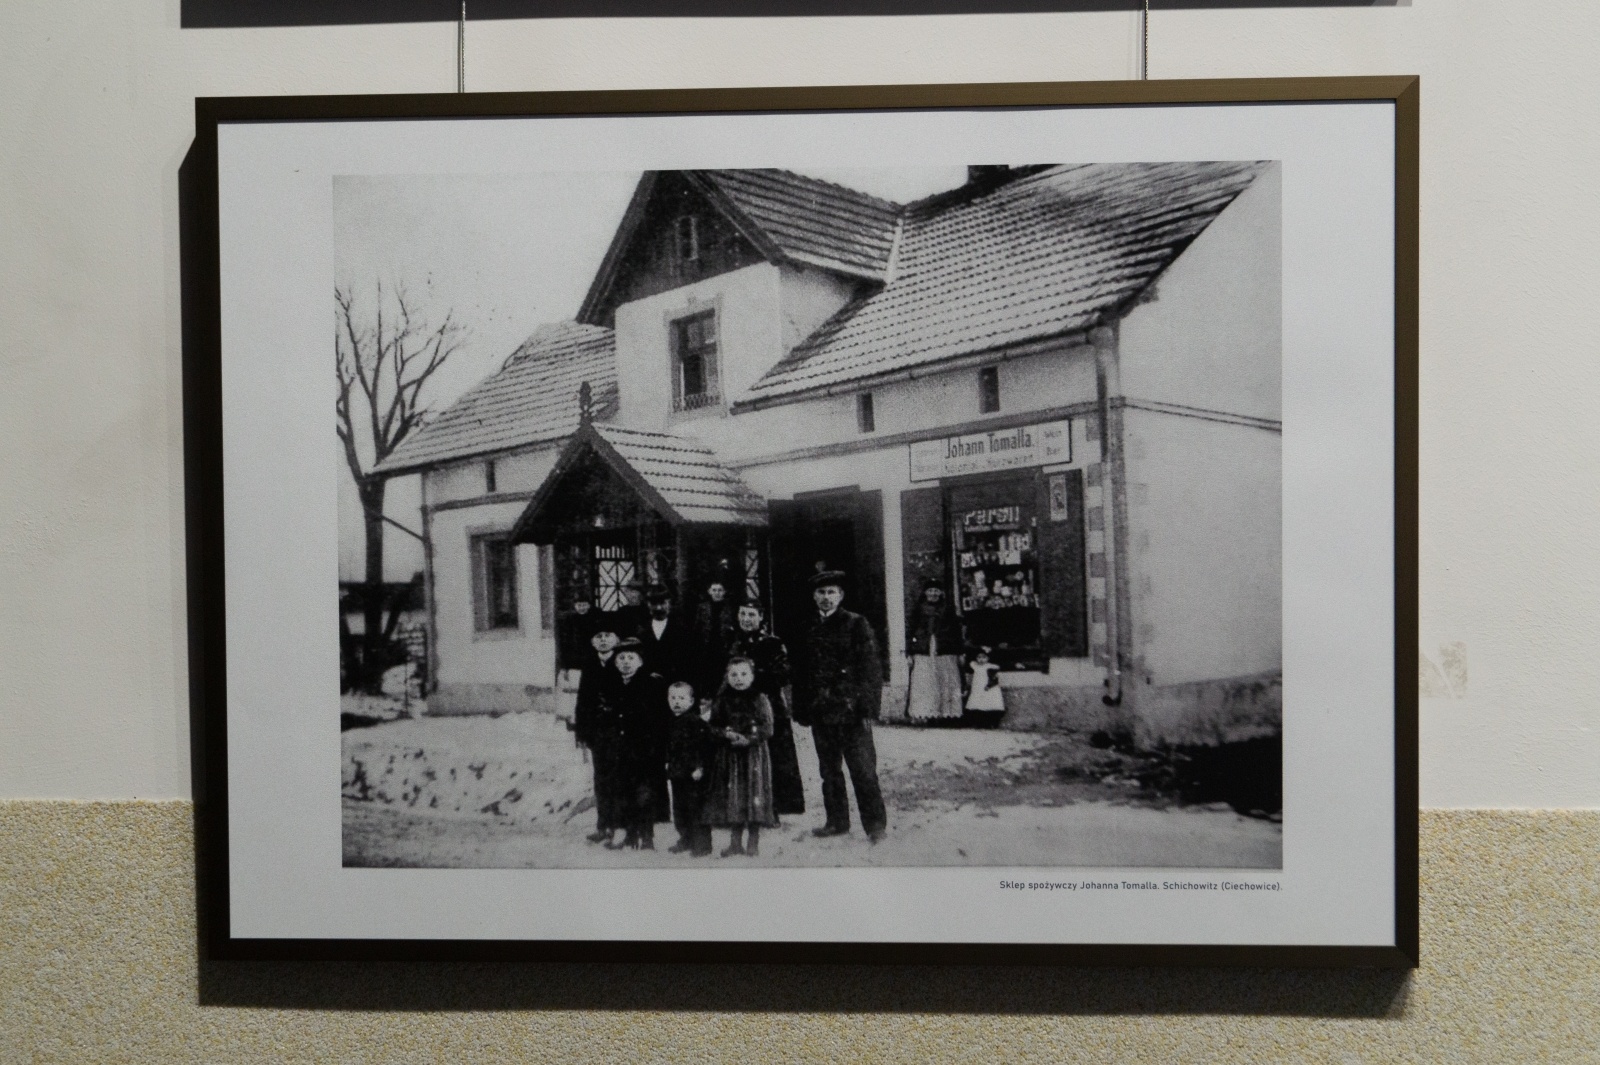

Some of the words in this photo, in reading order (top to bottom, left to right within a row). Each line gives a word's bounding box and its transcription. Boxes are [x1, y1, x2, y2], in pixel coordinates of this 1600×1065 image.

[944, 435, 985, 460] Johann
[999, 880, 1025, 891] Sklep
[1028, 880, 1078, 891] spożywczy
[1080, 881, 1119, 890] Johanna
[1121, 881, 1160, 890] Tomalla.
[1162, 881, 1218, 890] Schichowitz
[1221, 881, 1283, 891] (Ciechowice).
